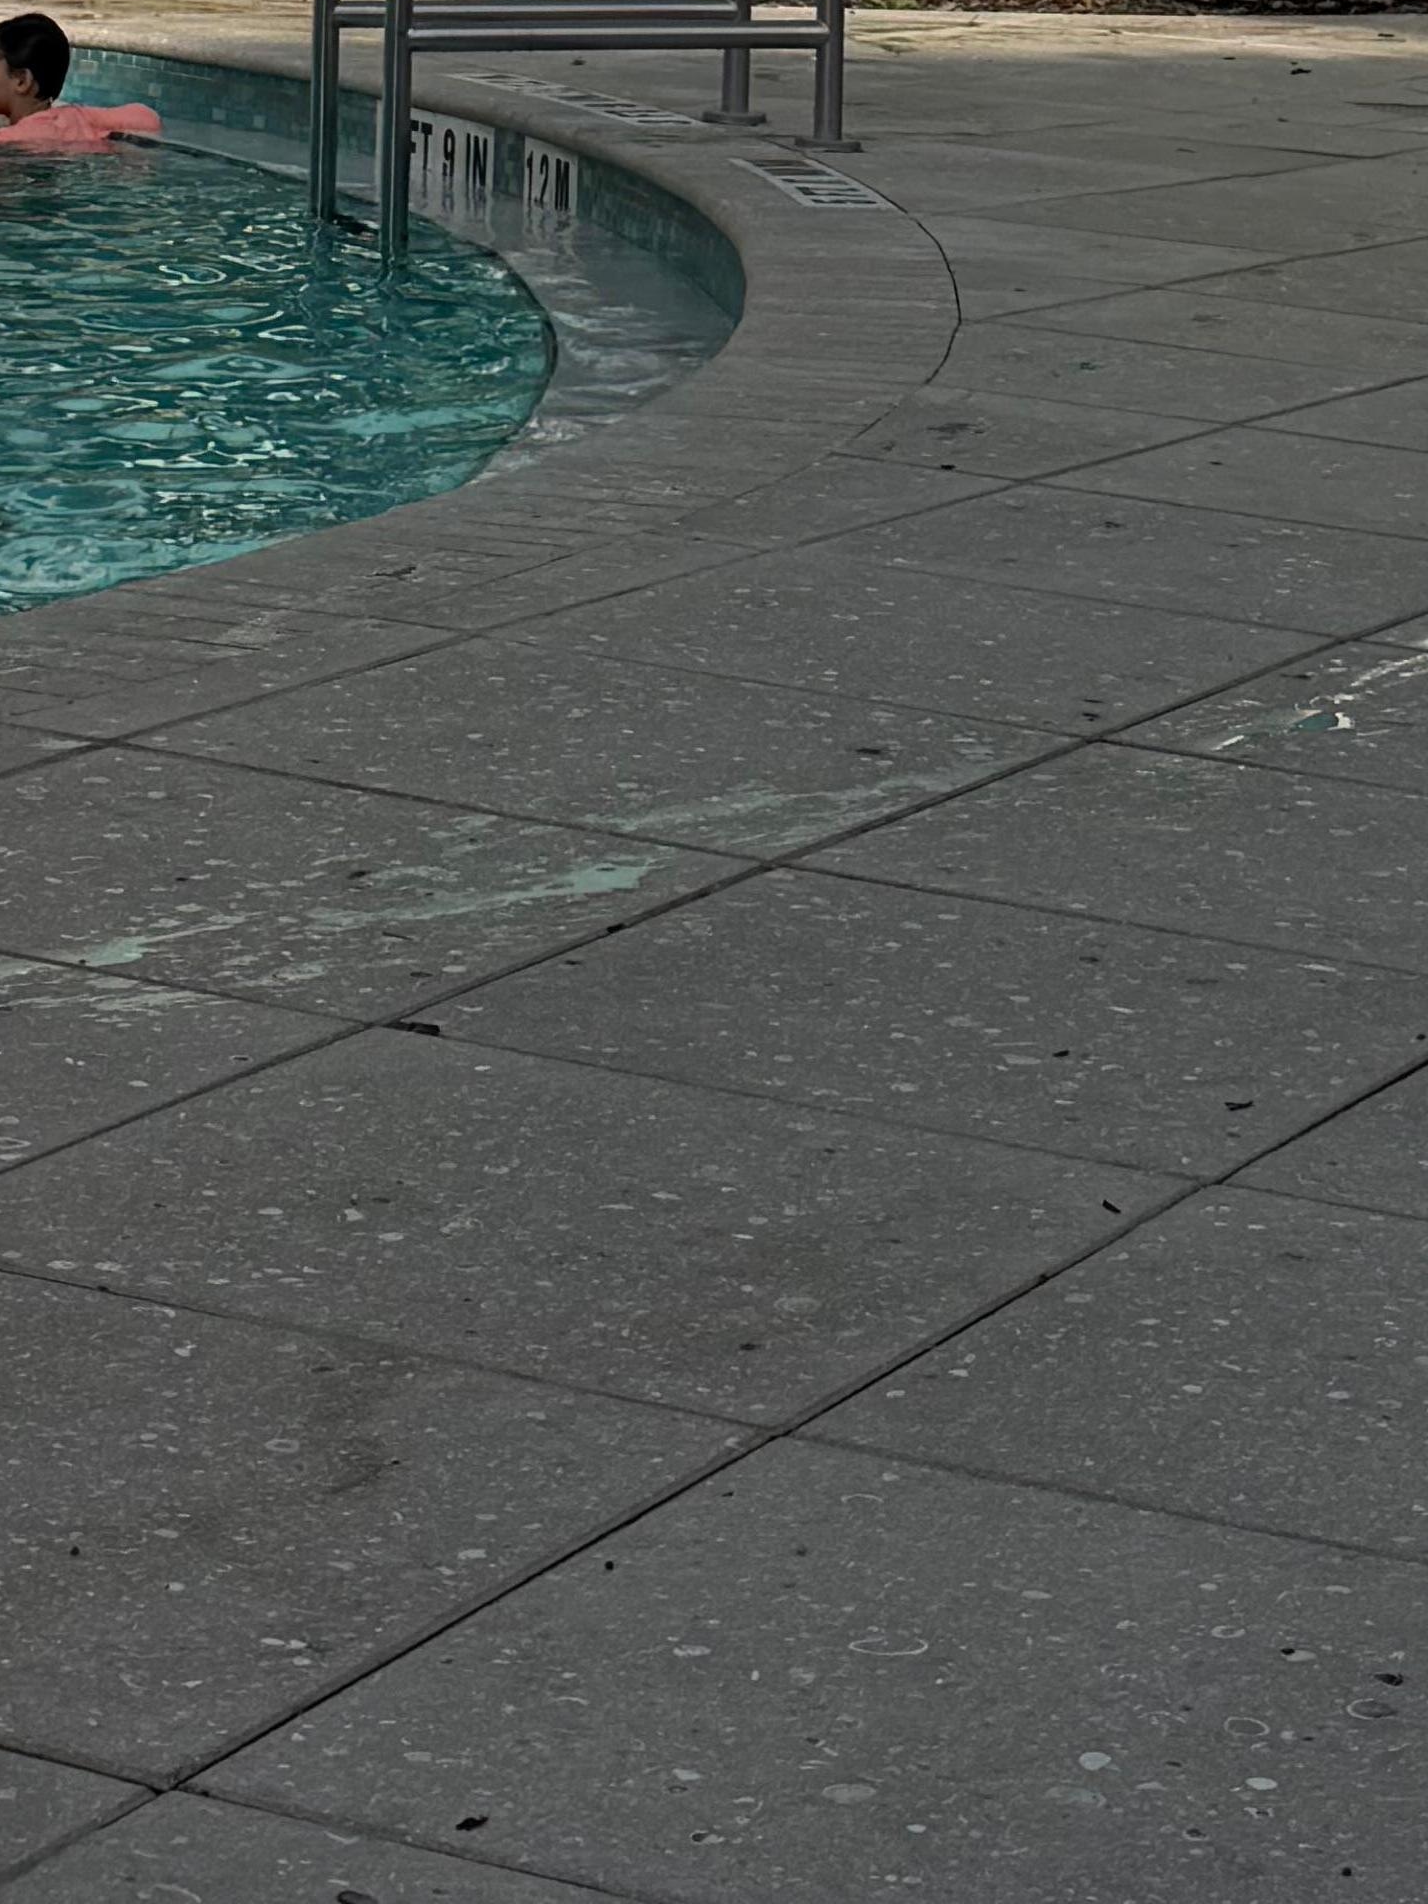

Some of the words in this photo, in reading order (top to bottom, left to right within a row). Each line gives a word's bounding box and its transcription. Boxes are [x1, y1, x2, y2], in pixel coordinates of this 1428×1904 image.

[442, 128, 456, 178] 9
[466, 132, 488, 187] IN
[554, 158, 570, 212] M
